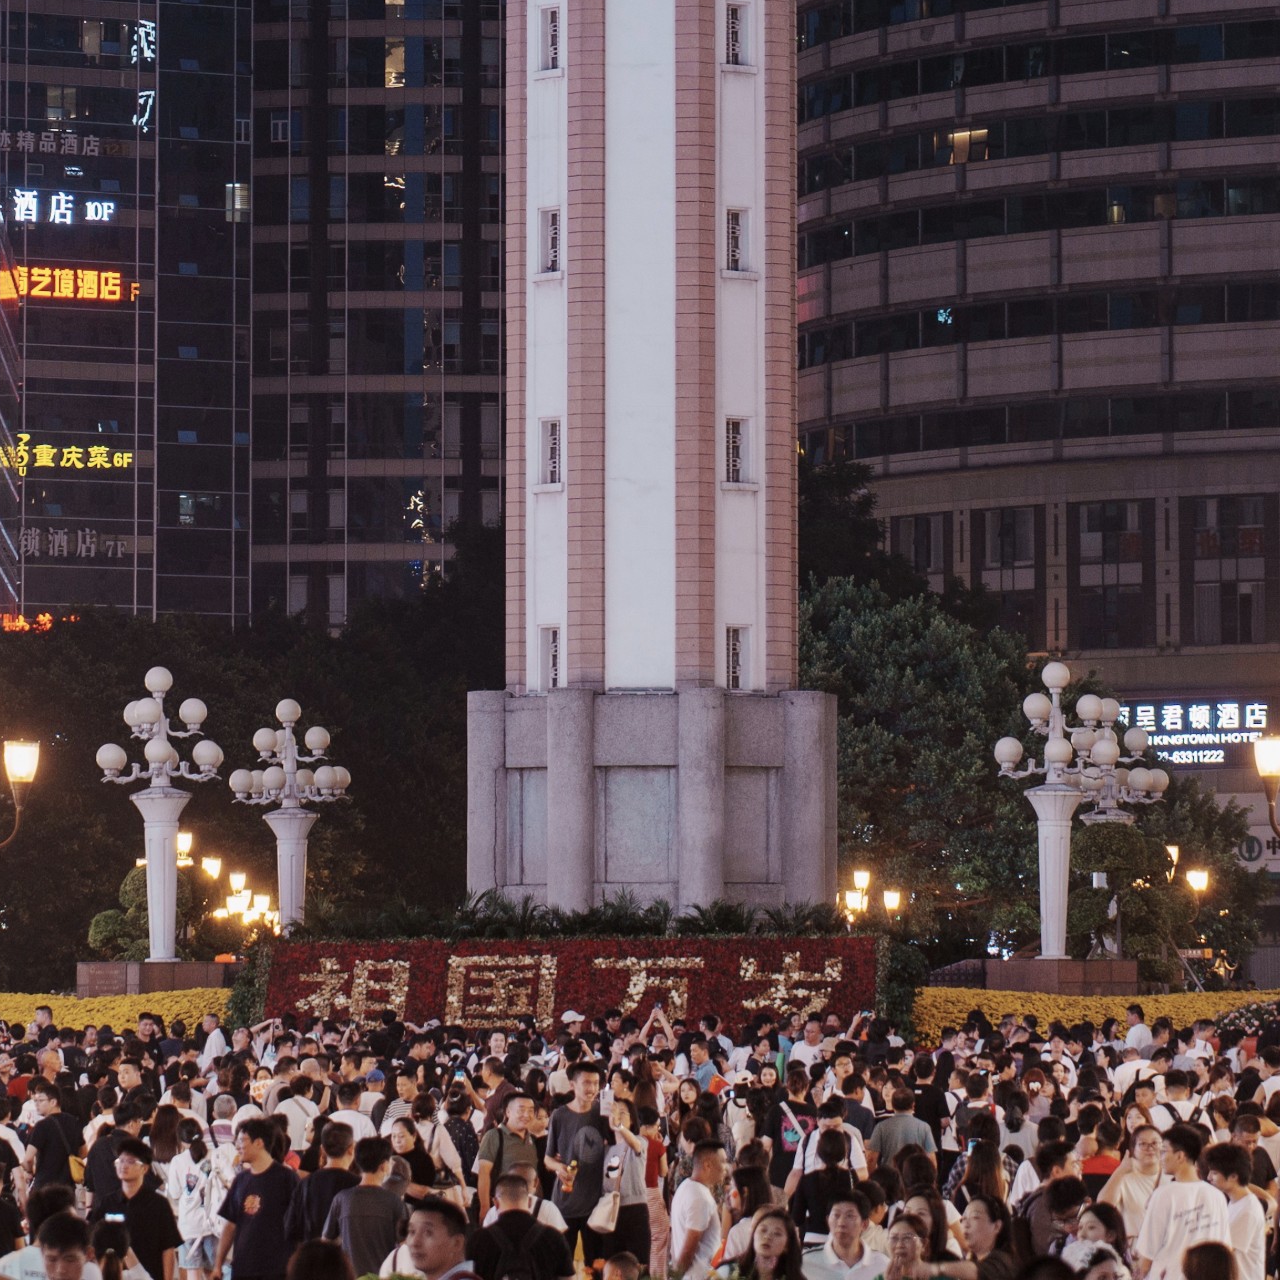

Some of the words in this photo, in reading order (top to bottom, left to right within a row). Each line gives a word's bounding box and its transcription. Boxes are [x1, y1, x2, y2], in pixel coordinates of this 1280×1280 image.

[0, 188, 74, 224] 酒店
[85, 201, 114, 221] 10F
[32, 444, 112, 469] 重庆菜
[113, 453, 133, 468] 6F
[295, 952, 843, 1031] 祖国万岁
